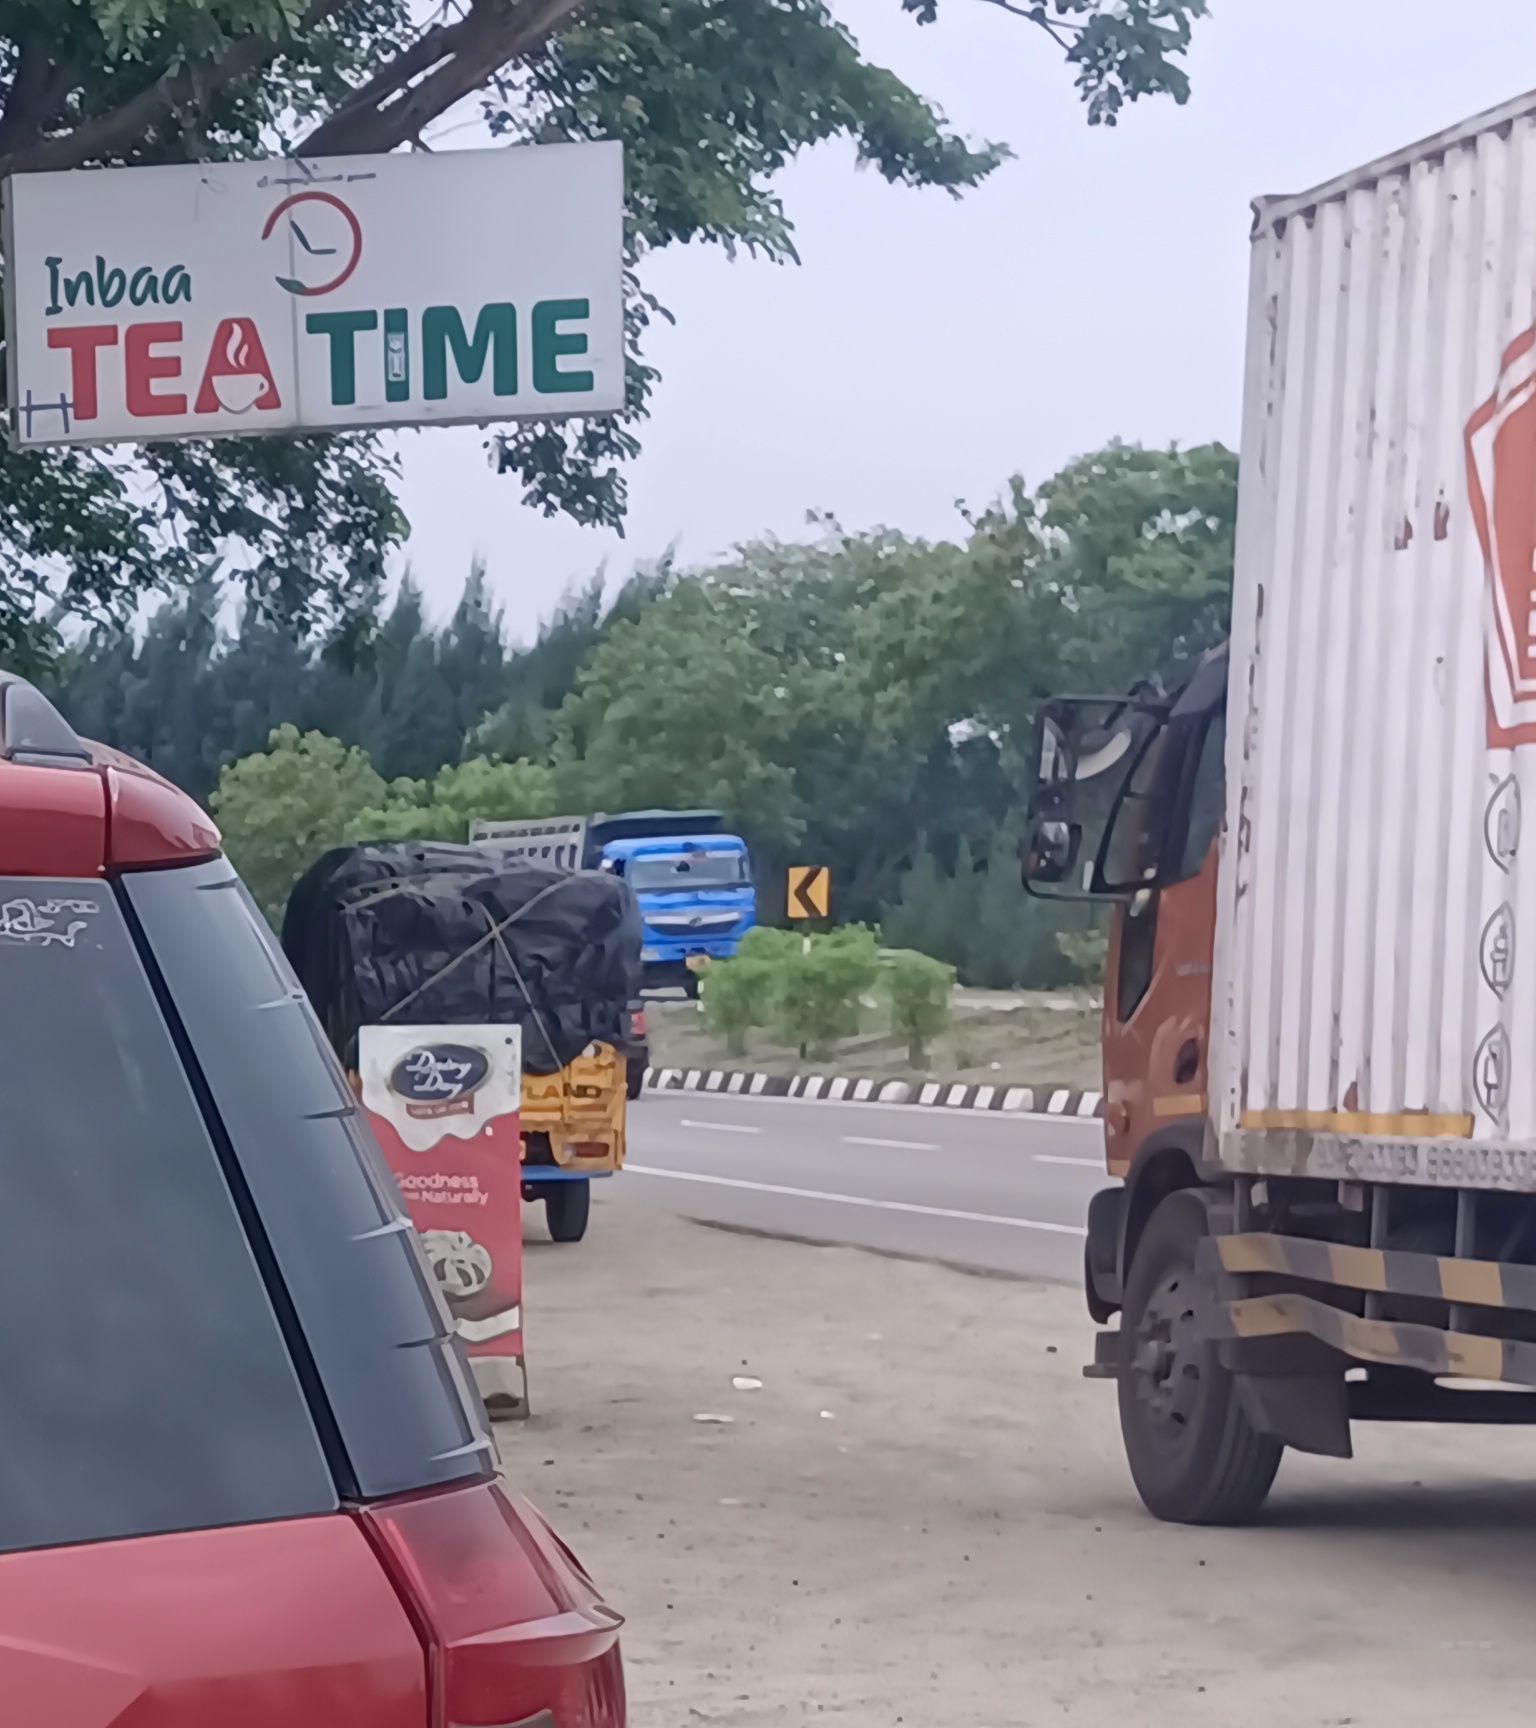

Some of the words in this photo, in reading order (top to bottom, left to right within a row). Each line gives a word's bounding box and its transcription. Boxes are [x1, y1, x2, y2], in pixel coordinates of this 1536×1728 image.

[44, 255, 192, 316] Inbaa
[46, 316, 282, 421] TEA
[305, 297, 595, 405] TIME
